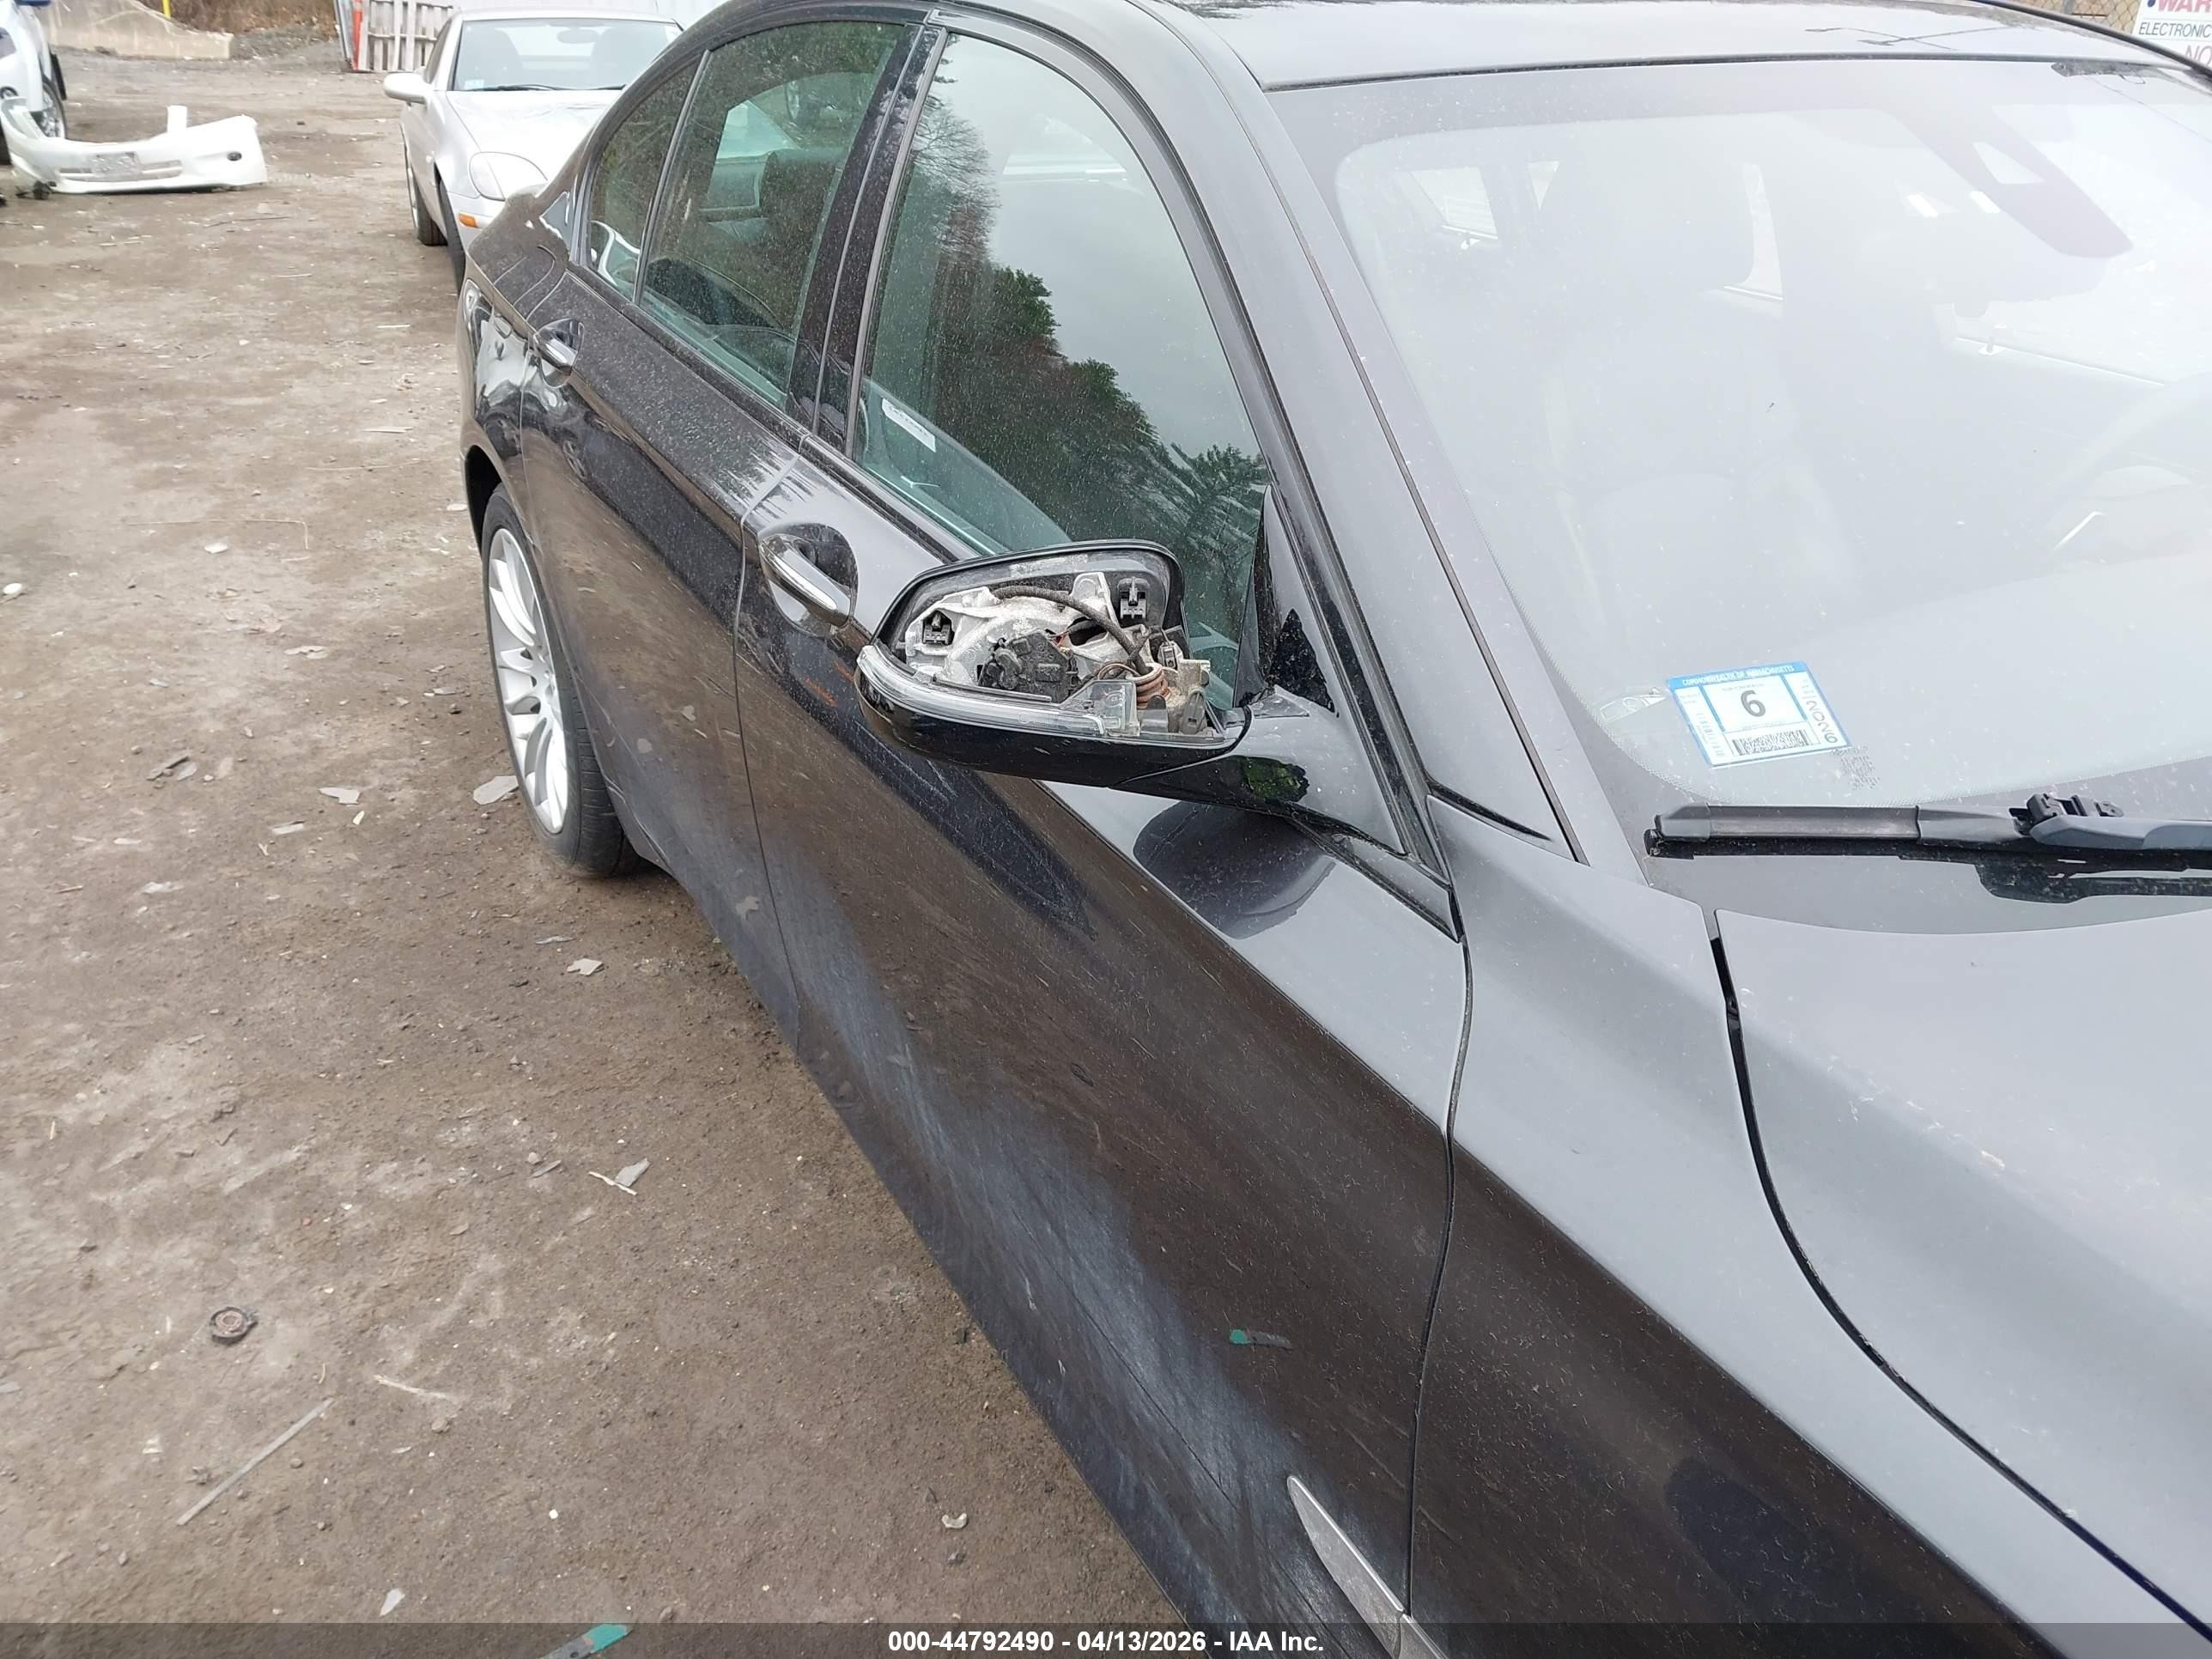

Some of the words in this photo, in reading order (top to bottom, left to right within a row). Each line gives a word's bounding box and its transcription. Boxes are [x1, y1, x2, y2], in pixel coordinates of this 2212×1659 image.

[2138, 21, 2212, 38] ELECTRONIC
[1740, 690, 1766, 717] 6
[1806, 700, 1838, 744] 2026
